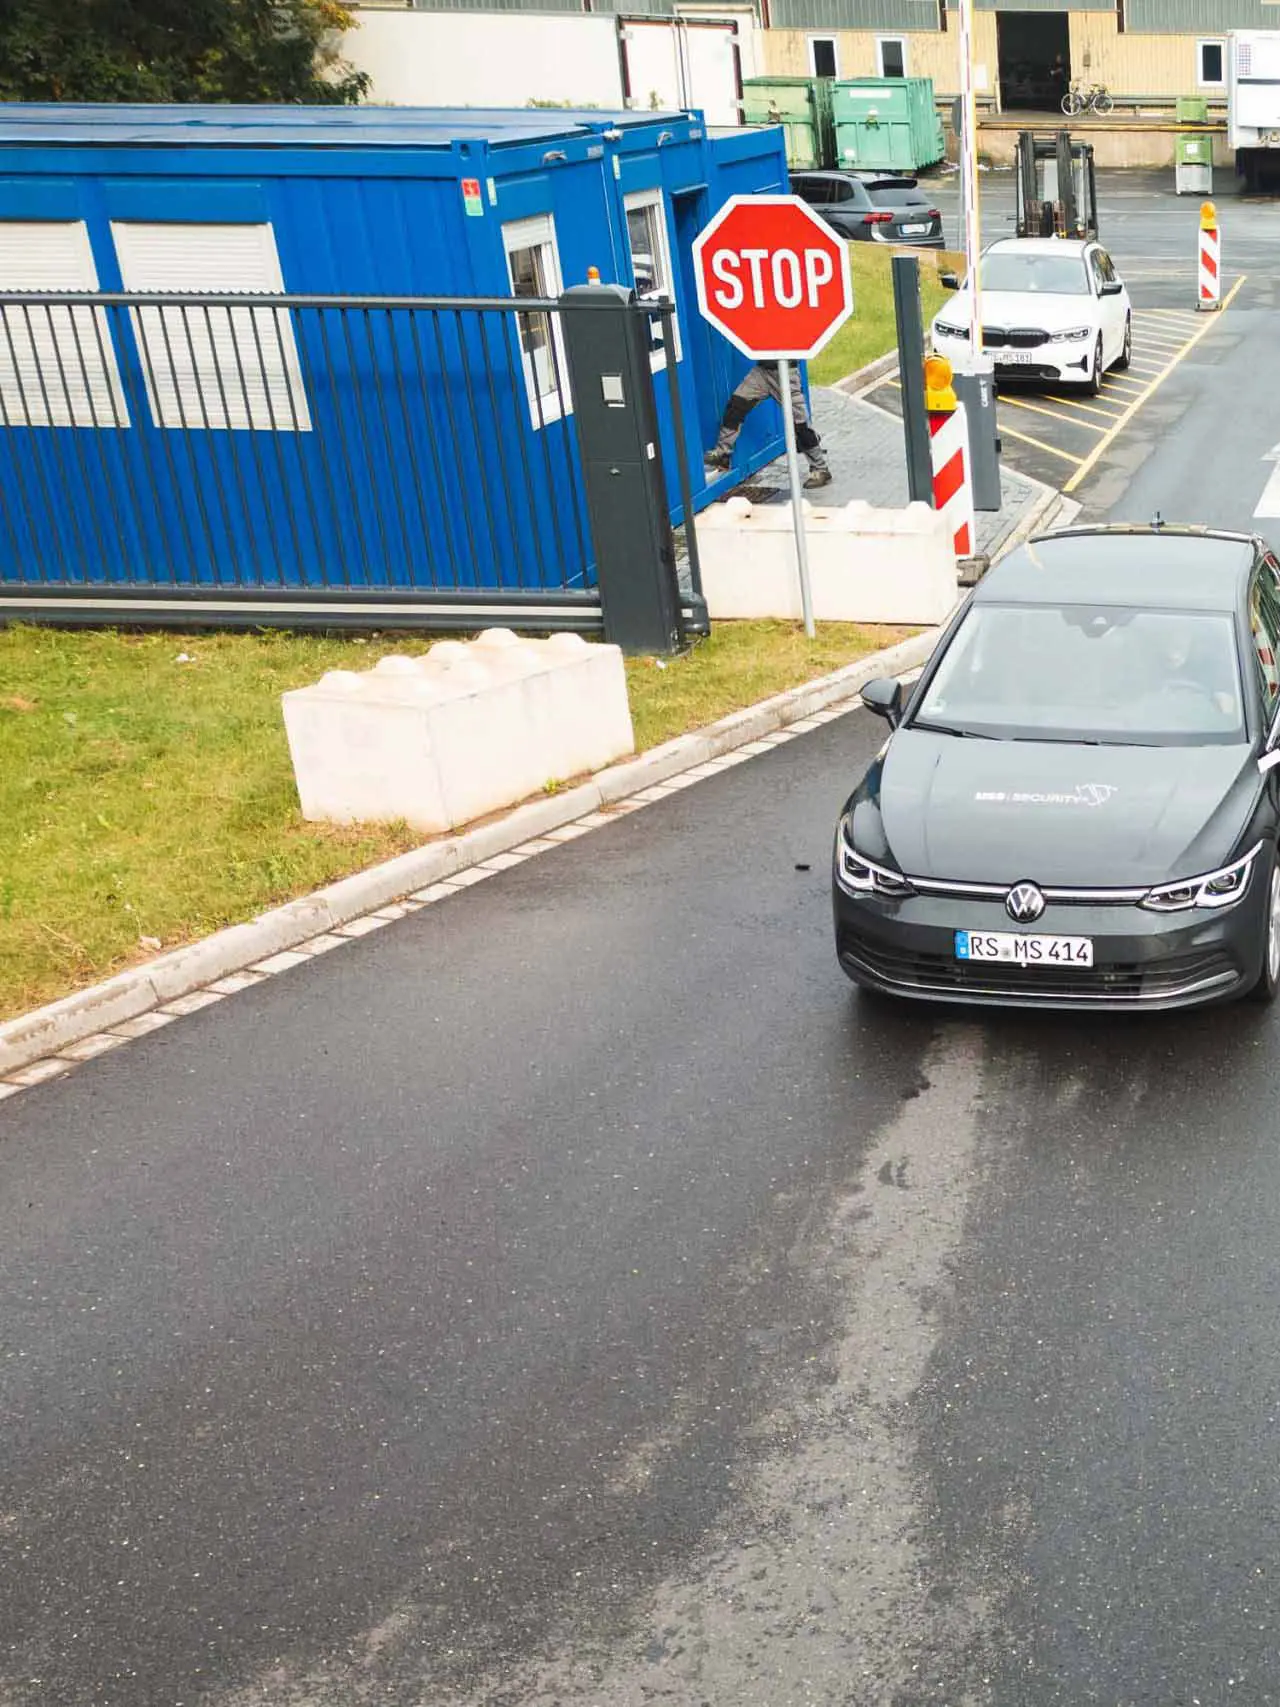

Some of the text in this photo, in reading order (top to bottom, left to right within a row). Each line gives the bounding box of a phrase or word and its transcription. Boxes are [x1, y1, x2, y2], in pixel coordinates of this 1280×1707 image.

[711, 248, 834, 310] STOP
[970, 936, 1089, 962] RS MS 414
